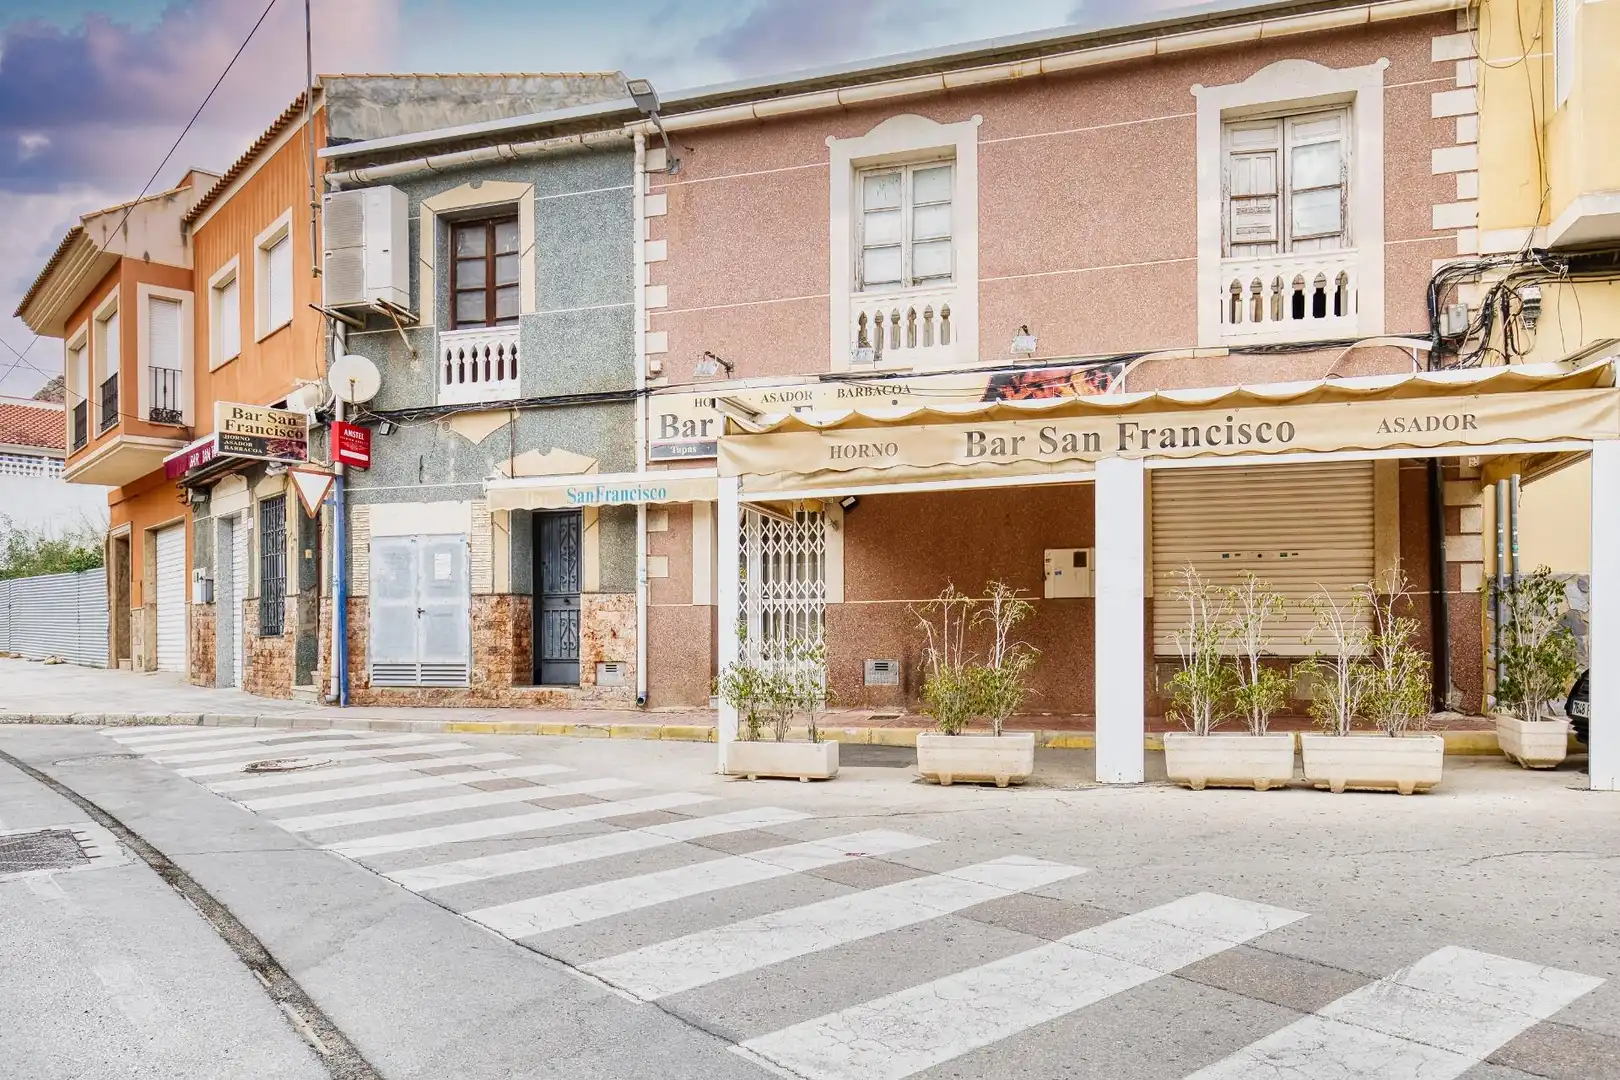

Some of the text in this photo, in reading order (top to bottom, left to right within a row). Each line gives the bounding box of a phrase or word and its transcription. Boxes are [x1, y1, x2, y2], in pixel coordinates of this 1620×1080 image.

[760, 384, 911, 404] ASADOR BARBACOA
[232, 407, 298, 427] Bar San
[658, 413, 714, 440] Bar
[1376, 413, 1478, 435] ASADOR
[224, 419, 304, 440] Francisco
[343, 428, 365, 441] AMSTEL
[964, 415, 1296, 459] Bar San Francisco
[828, 442, 899, 459] HORNO
